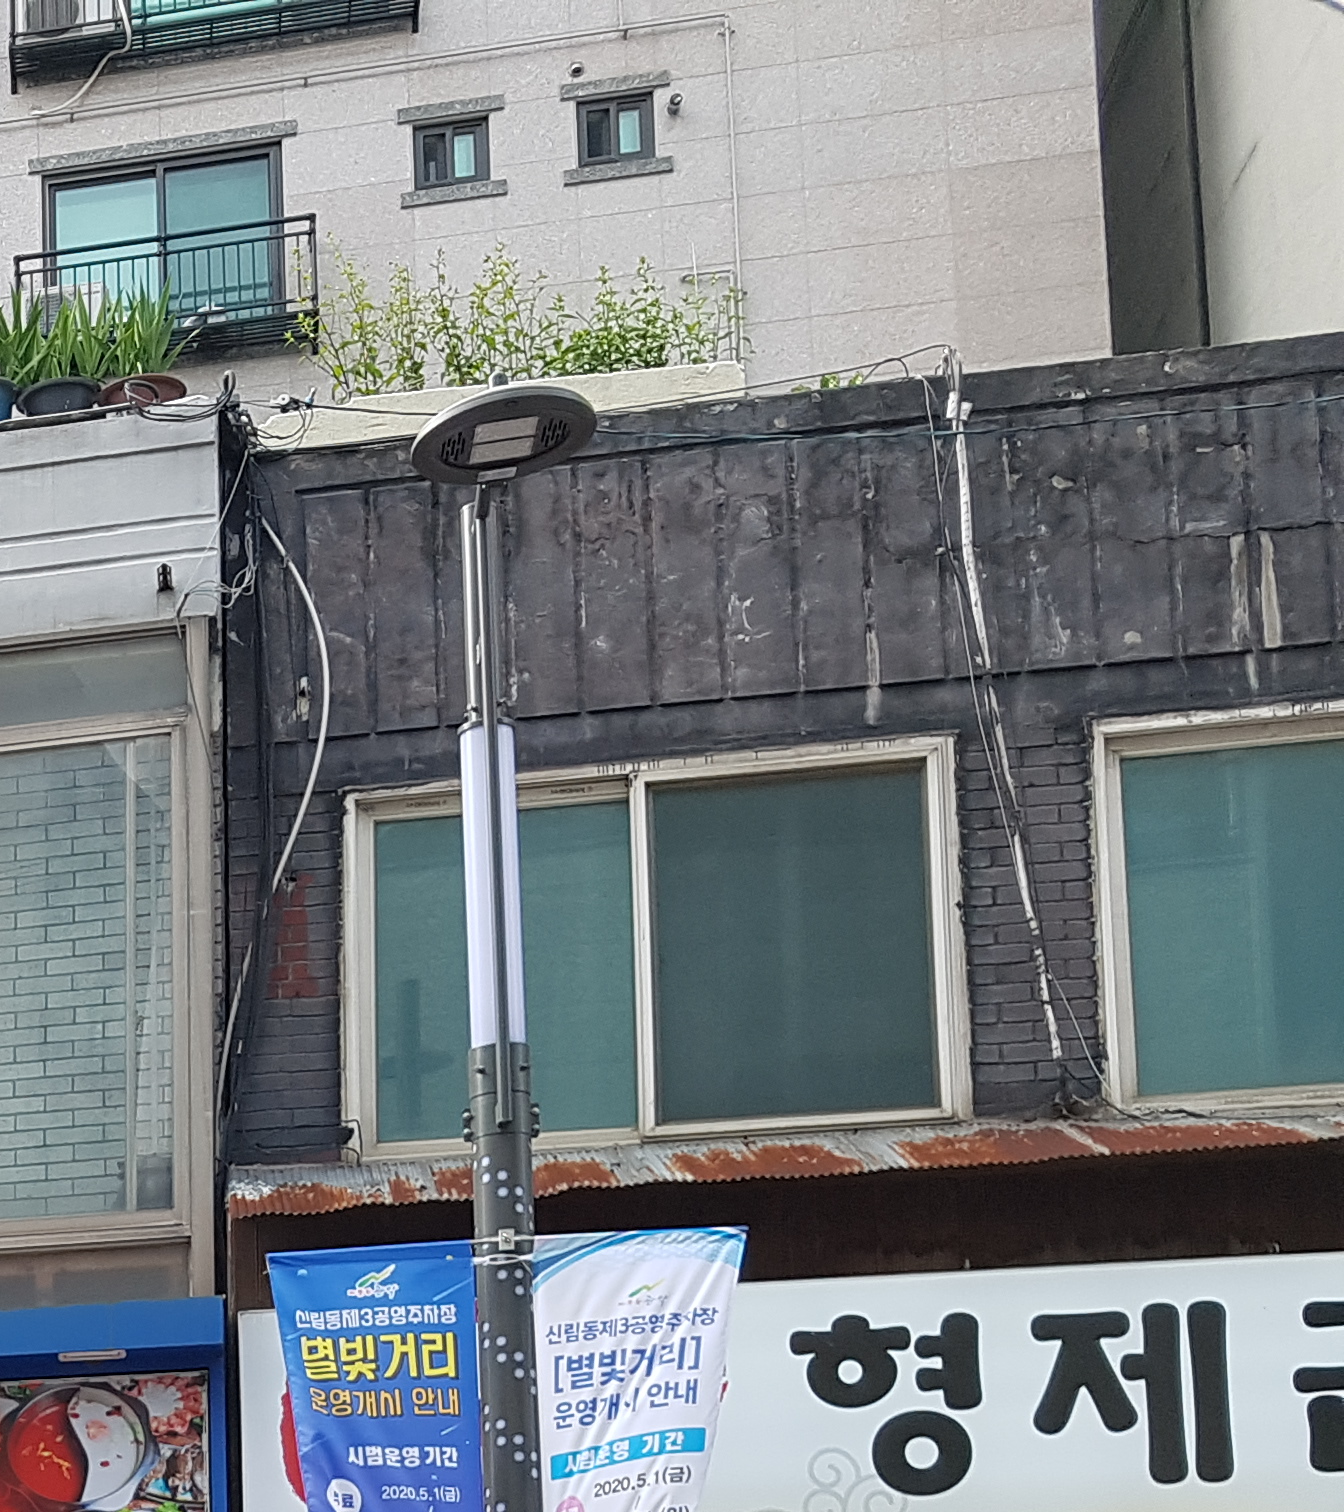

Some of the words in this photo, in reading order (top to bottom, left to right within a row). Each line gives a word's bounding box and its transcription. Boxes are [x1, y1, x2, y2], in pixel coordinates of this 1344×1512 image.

[296, 1304, 457, 1330] 신림동제3공영주차장
[545, 1307, 719, 1345] 신림동제3공영주차장
[300, 1332, 459, 1381] 별빛거리
[554, 1336, 702, 1394] [별빛거리]
[309, 1387, 403, 1417] 운영개시
[412, 1387, 460, 1416] 안내
[647, 1378, 698, 1408] 안내
[348, 1446, 421, 1467] 시범운영
[424, 1446, 459, 1467] 기간
[642, 1431, 685, 1454] 기간
[381, 1485, 461, 1503] 2020.5.1(금)
[594, 1465, 692, 1497] 2020.5.1(금)
